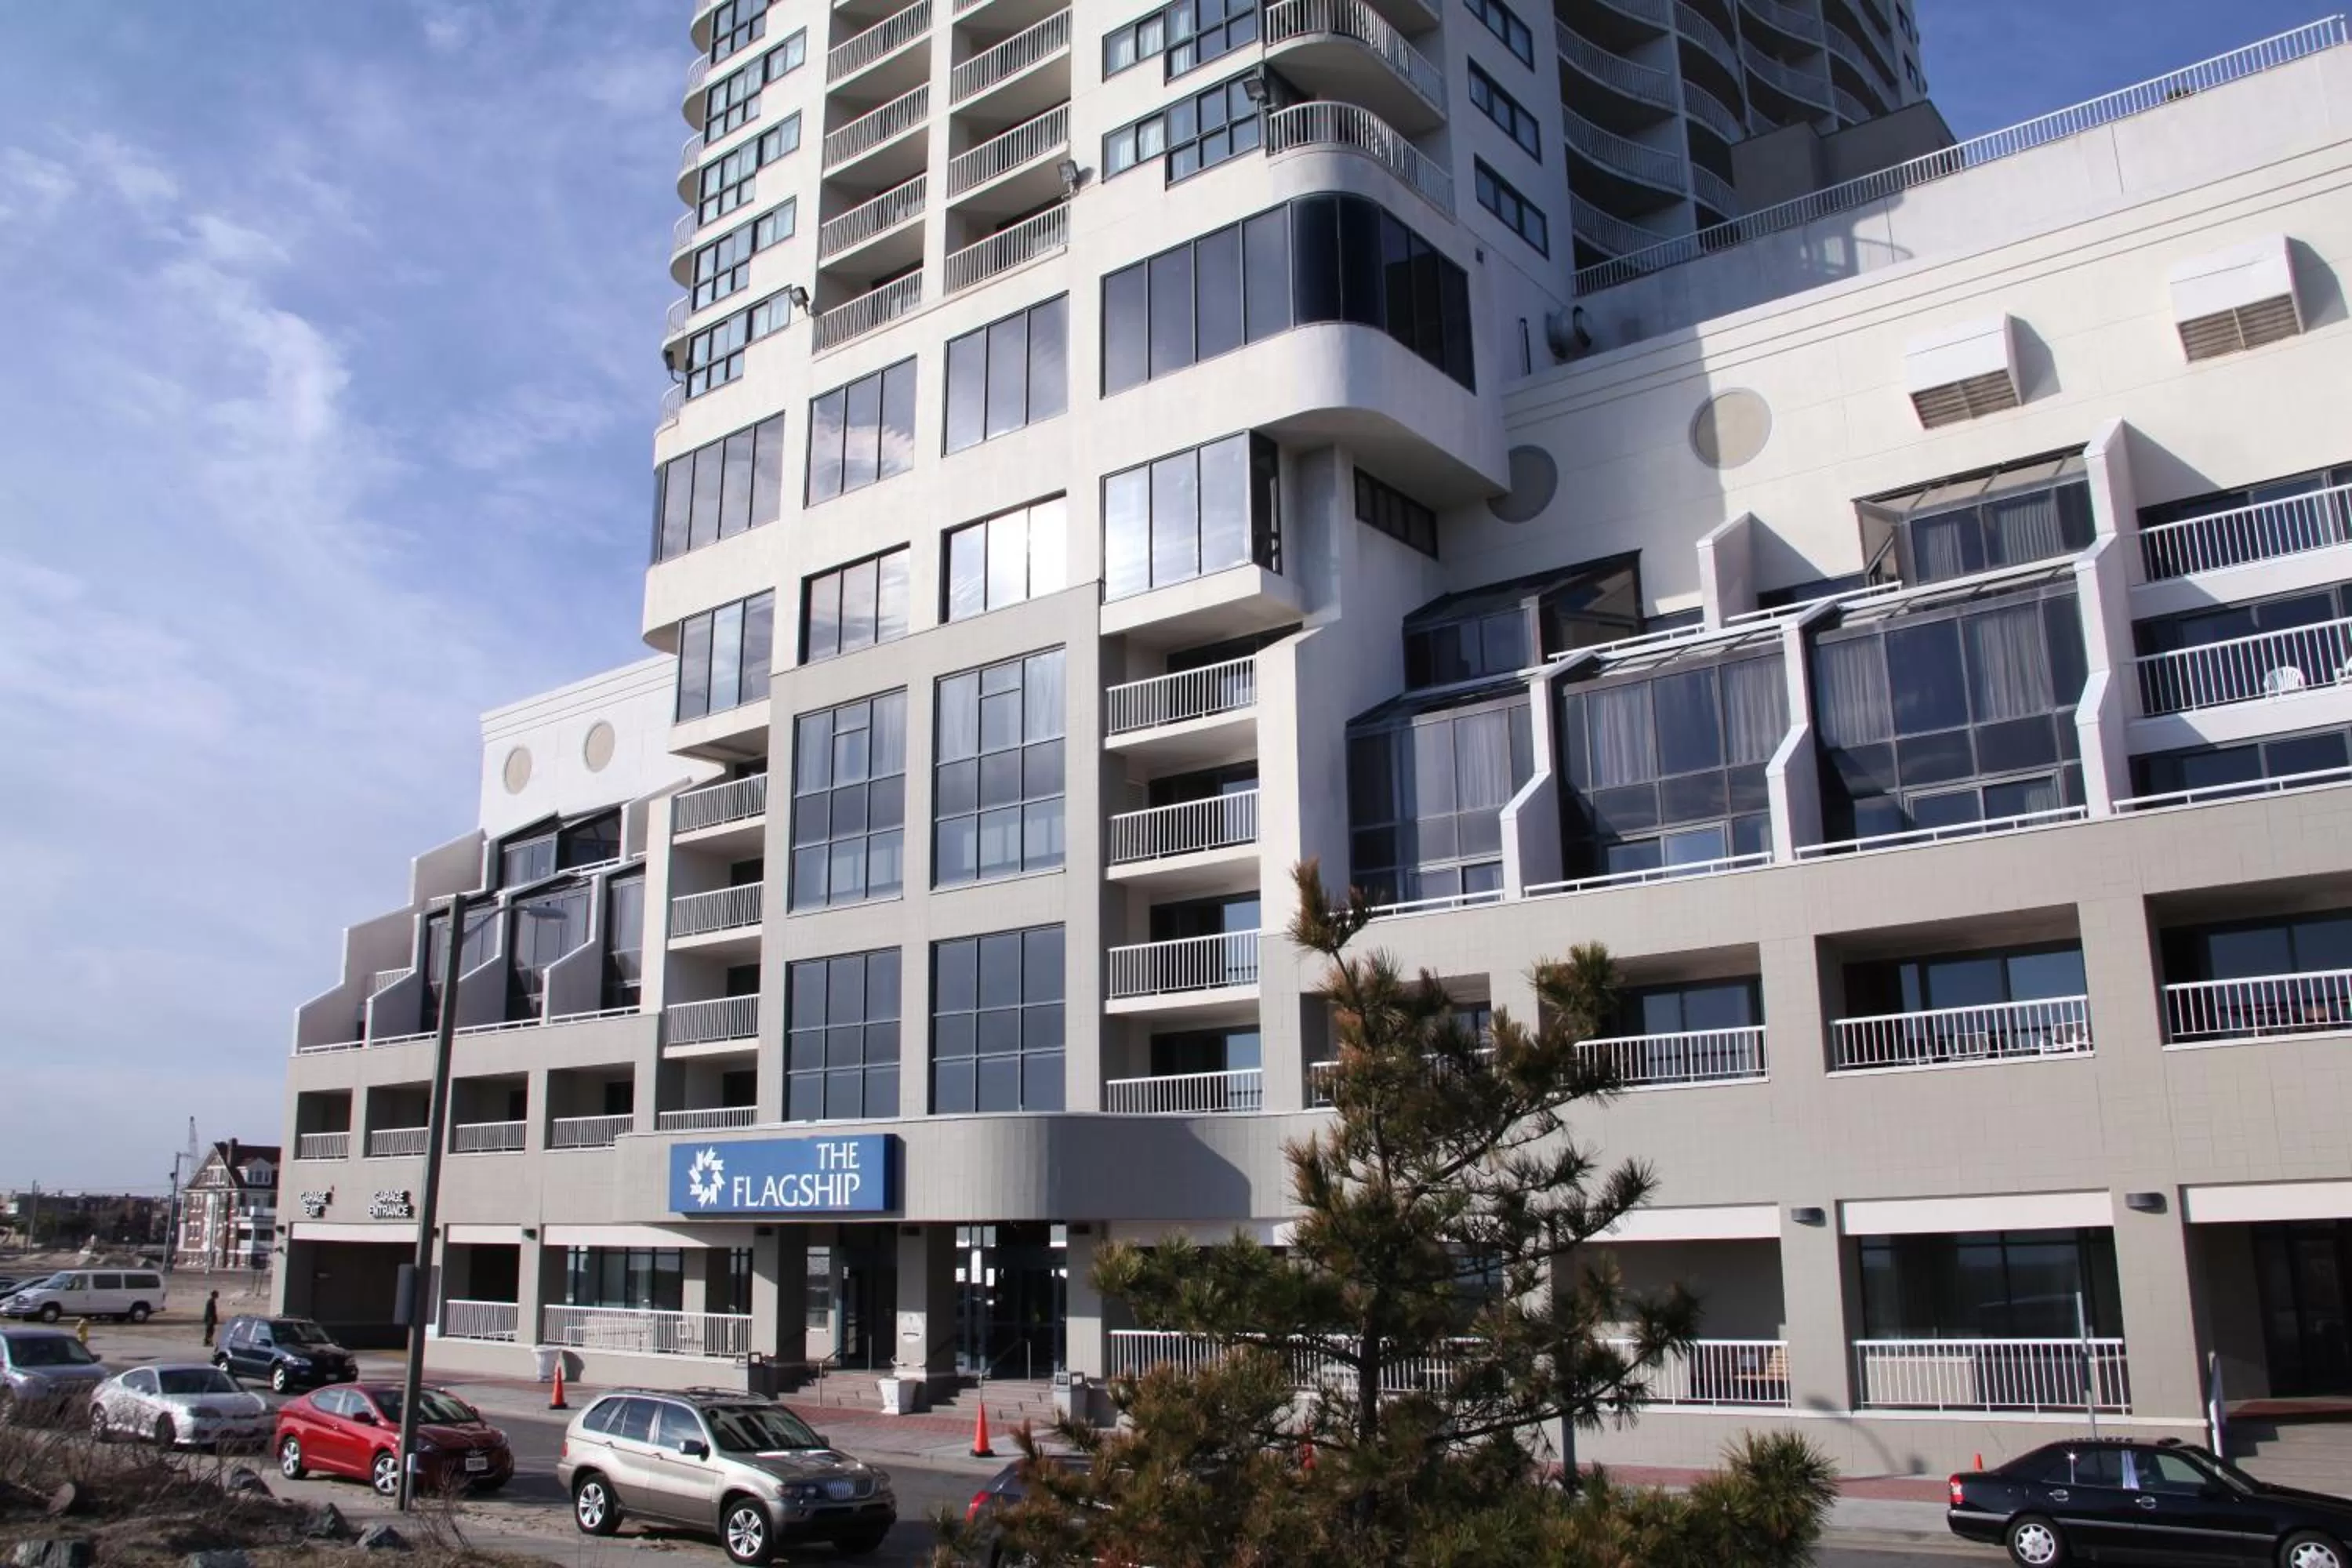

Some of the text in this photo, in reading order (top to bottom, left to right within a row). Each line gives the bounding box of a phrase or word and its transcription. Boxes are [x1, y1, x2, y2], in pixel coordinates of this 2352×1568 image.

[816, 1142, 860, 1170] THE
[374, 1190, 404, 1203] GARAGE
[732, 1173, 860, 1207] FLAGSHIP
[369, 1204, 408, 1217] ENTRANCE
